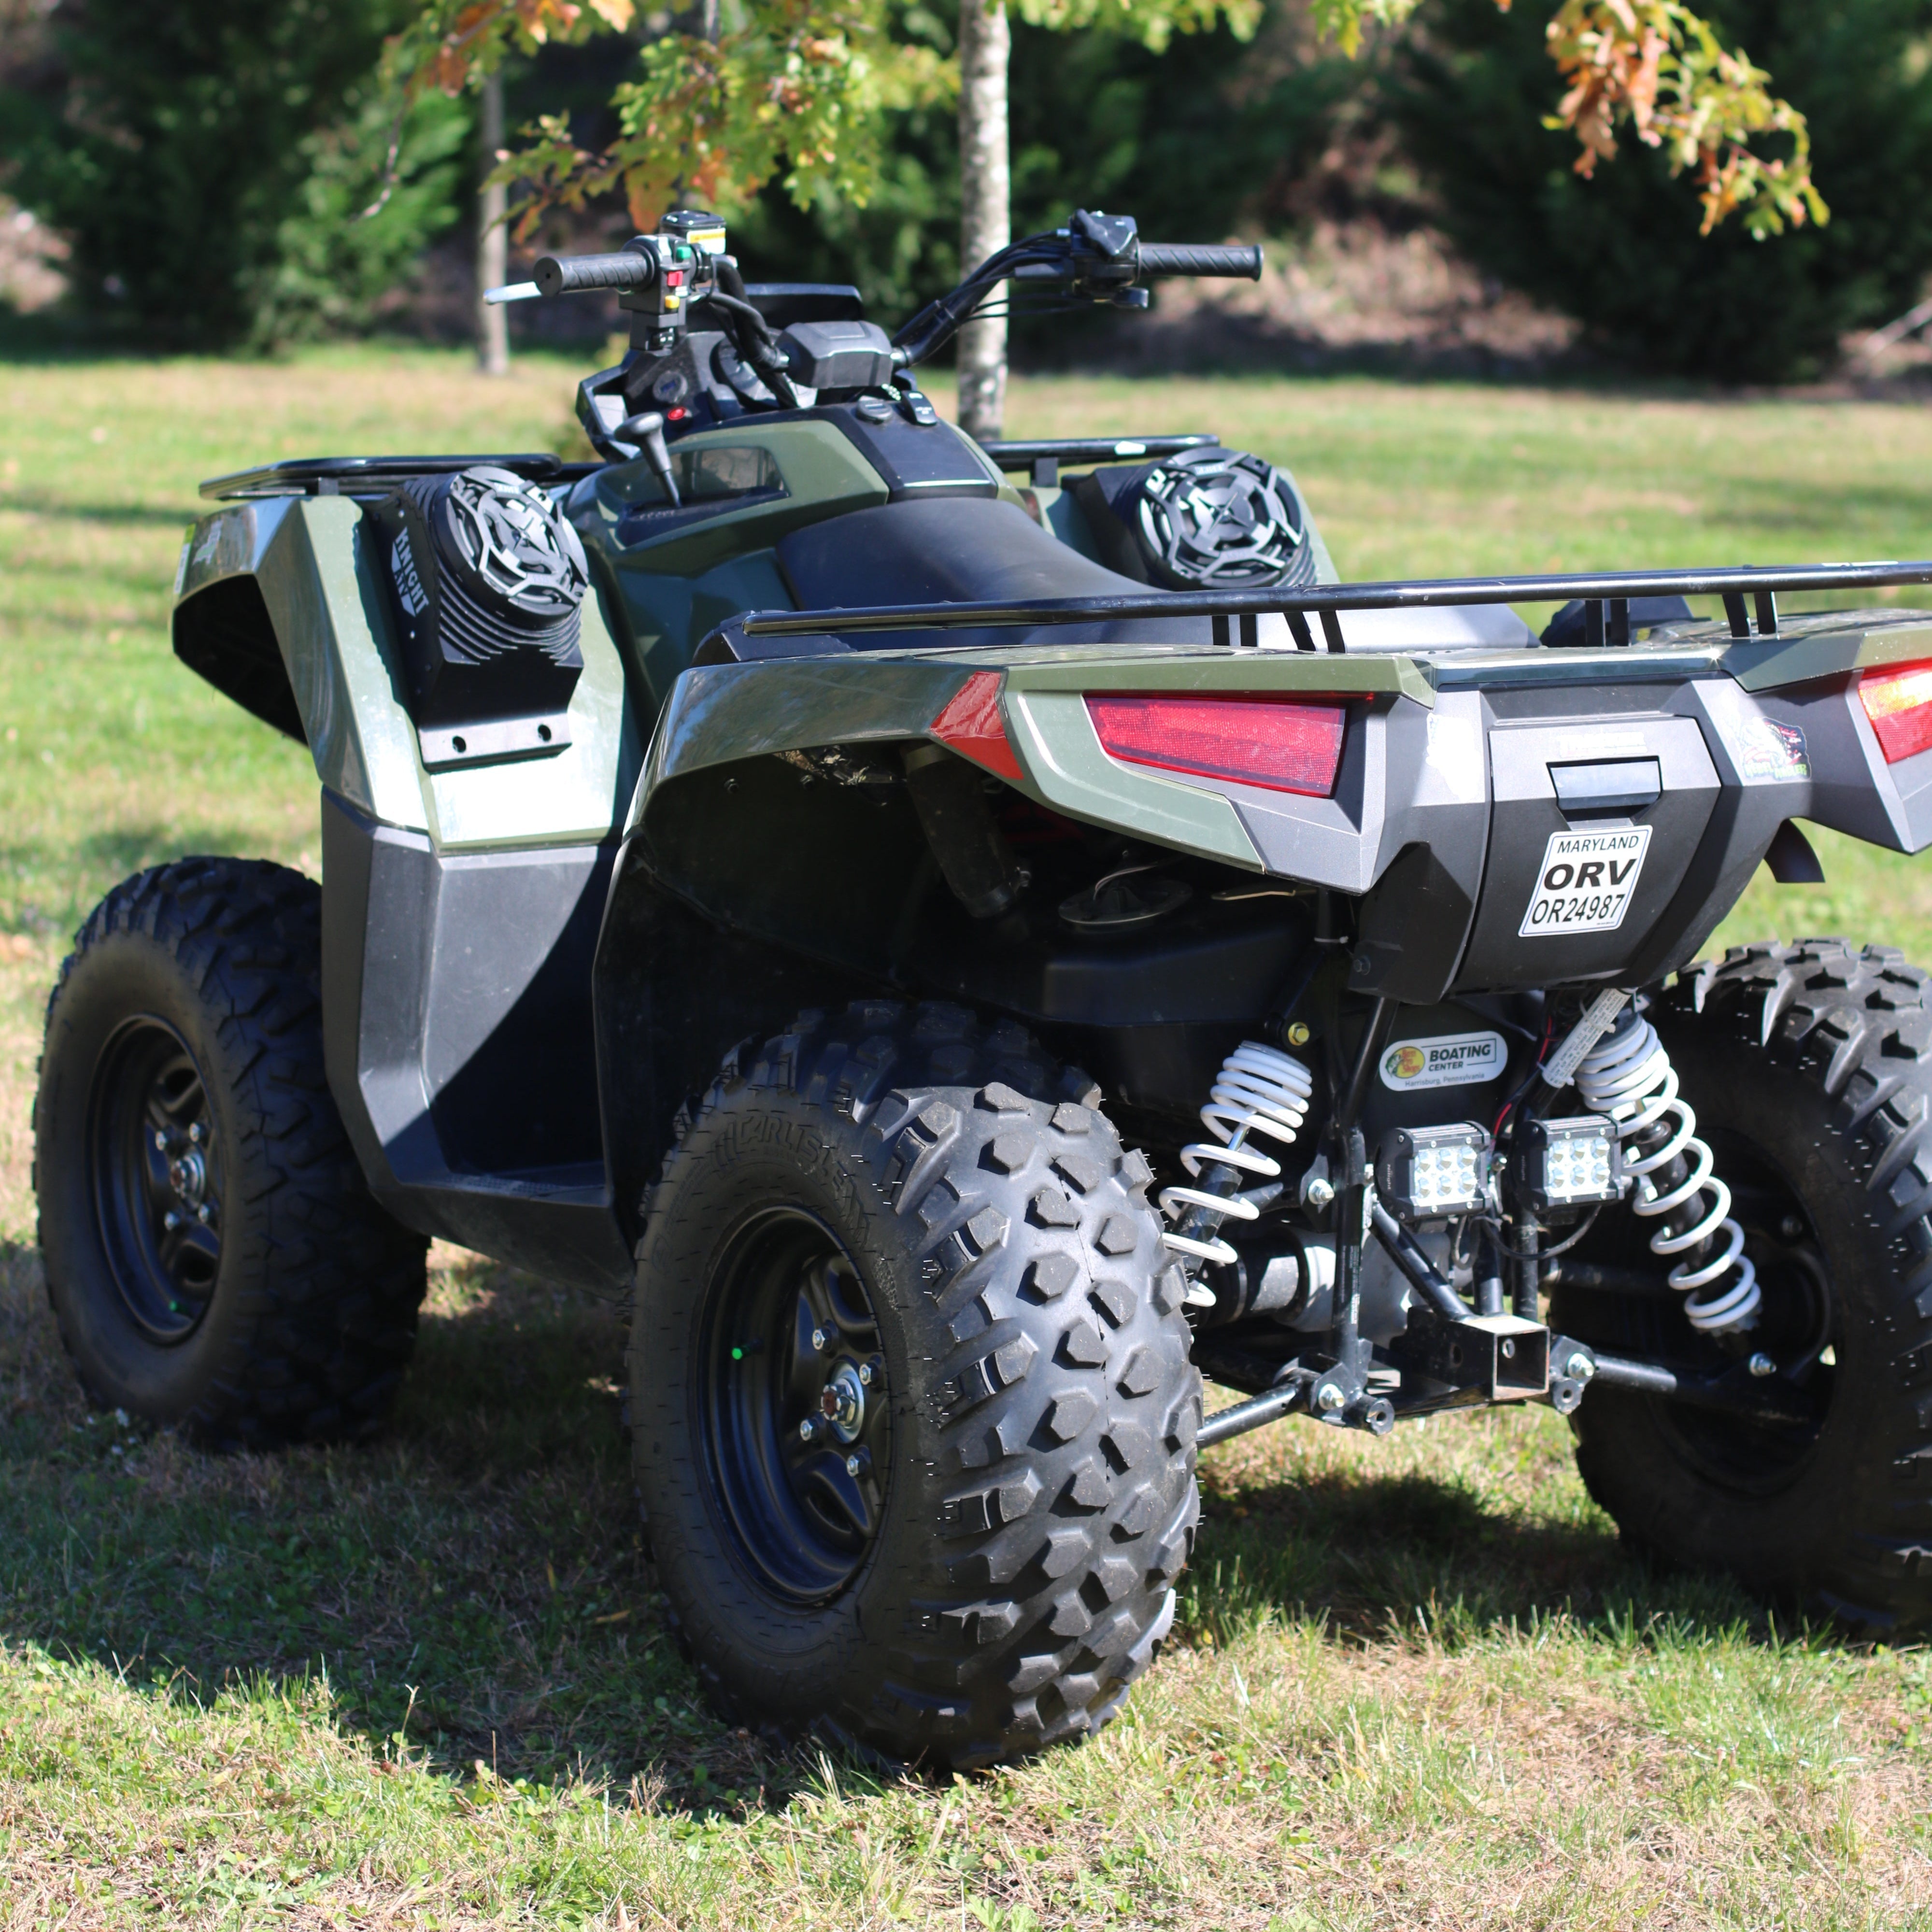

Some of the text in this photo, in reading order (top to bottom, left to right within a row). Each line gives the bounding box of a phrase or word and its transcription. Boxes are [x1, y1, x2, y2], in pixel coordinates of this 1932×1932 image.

[394, 525, 430, 615] KNIGHT
[1557, 835, 1639, 854] MARYLAND
[1544, 859, 1637, 891] ORV
[1532, 894, 1626, 925] OR24987
[1429, 1044, 1492, 1063] BOATING
[1428, 1061, 1464, 1072] CENTER
[1405, 1073, 1485, 1088] Harrisburg, Pennsylvania
[735, 1115, 852, 1190] CARLISLE
